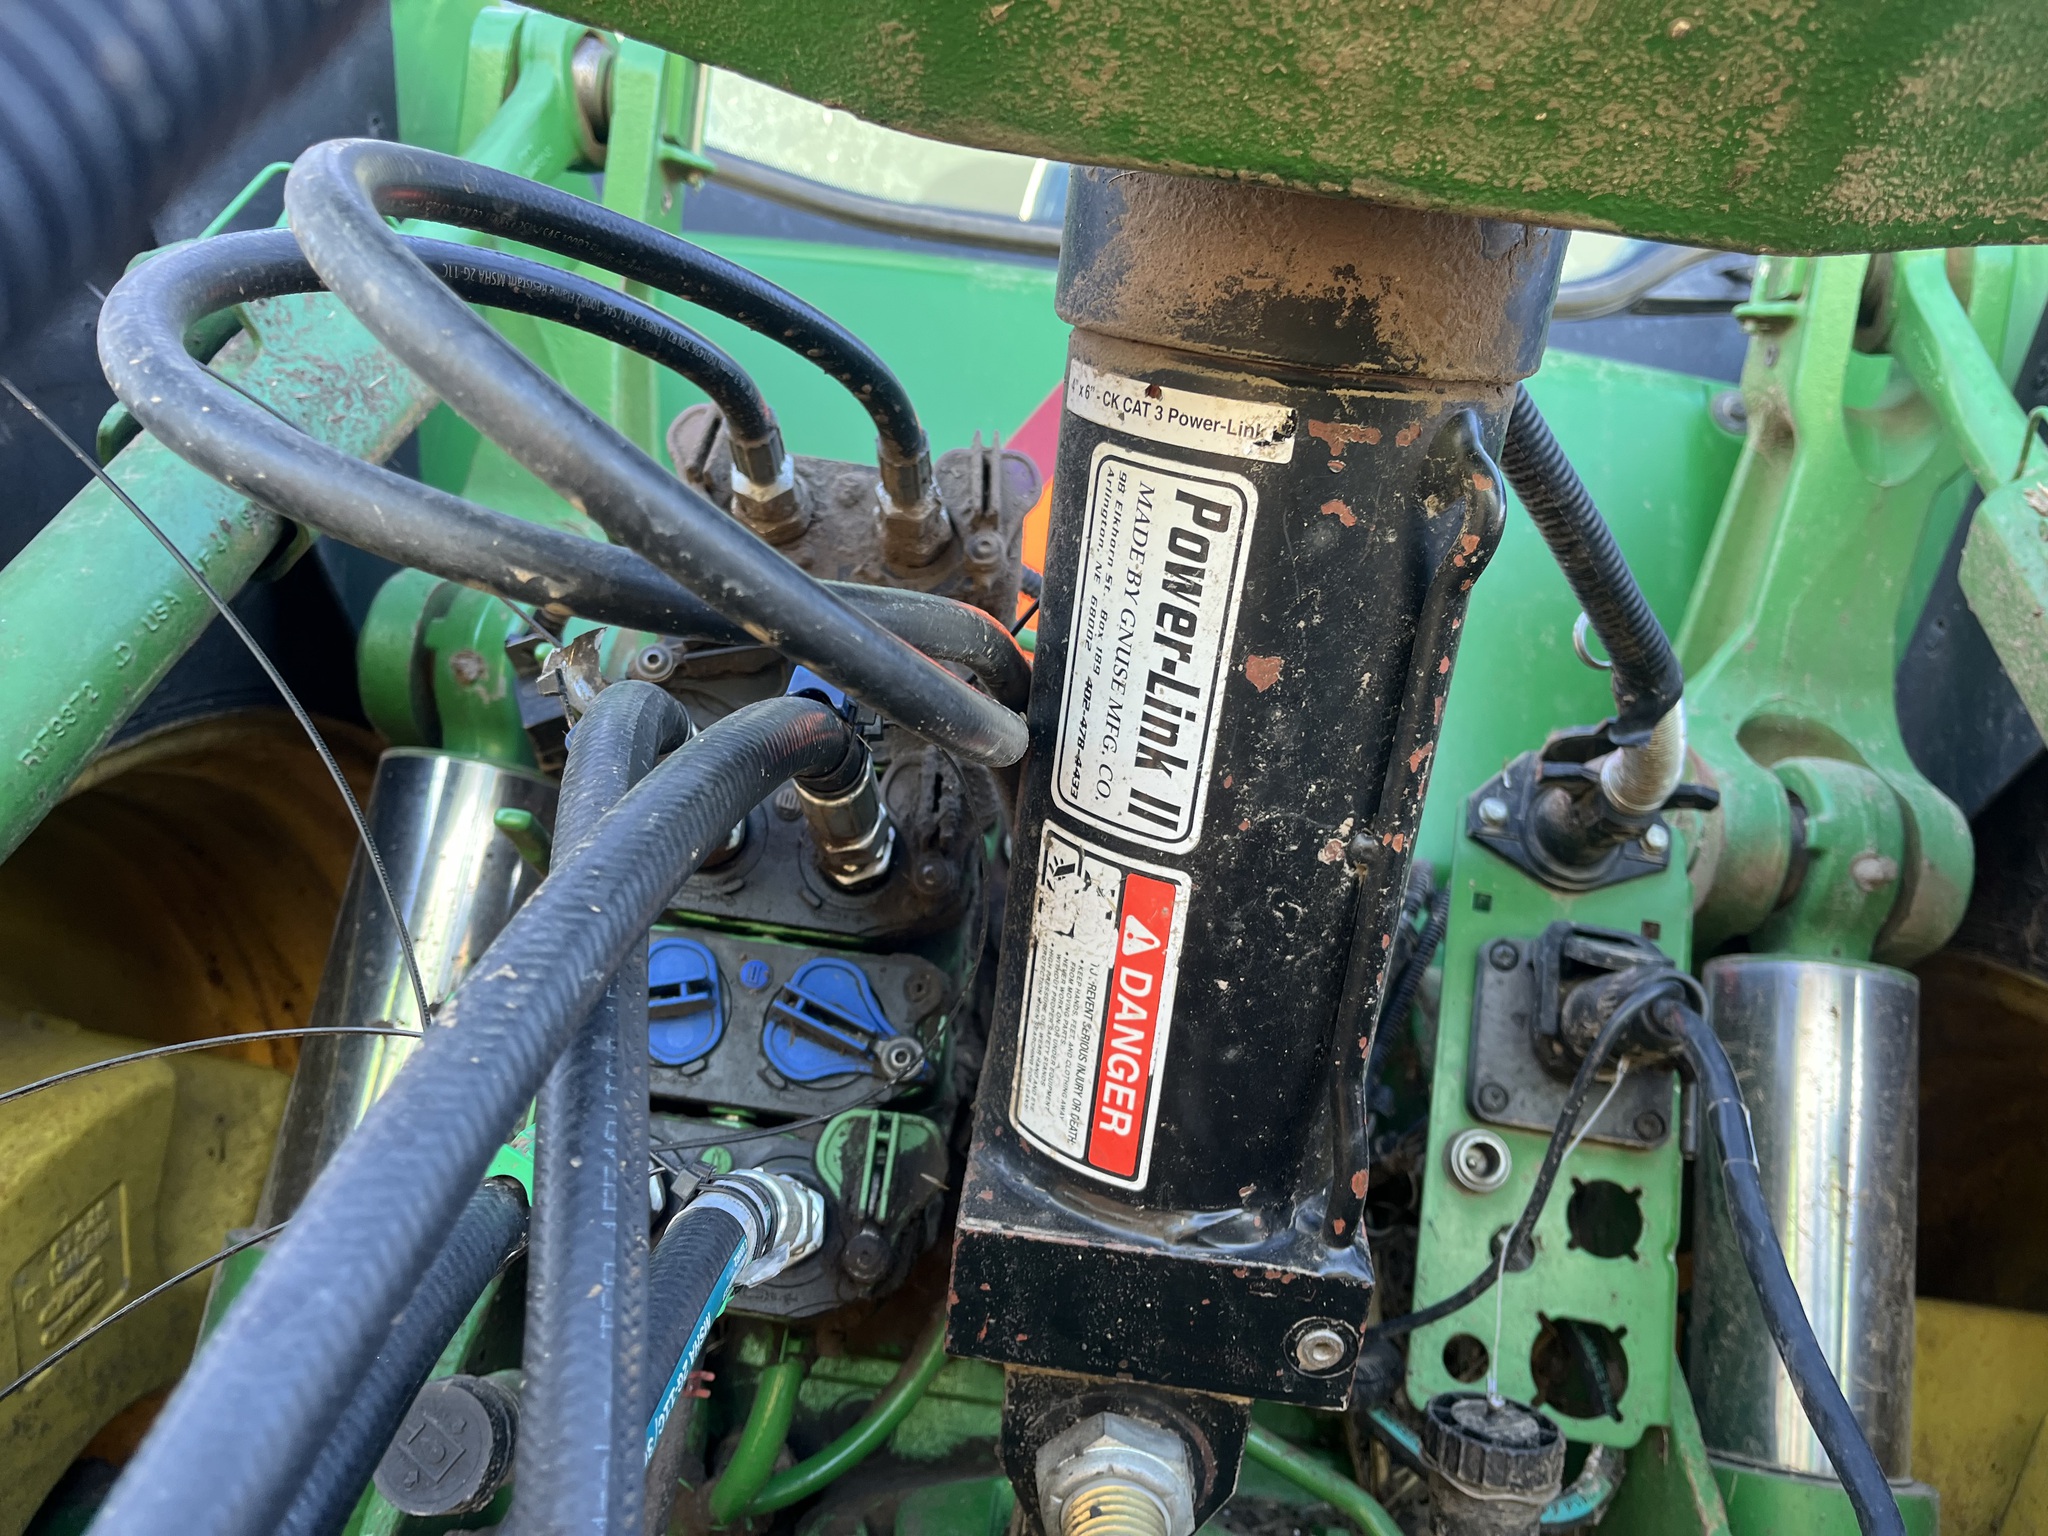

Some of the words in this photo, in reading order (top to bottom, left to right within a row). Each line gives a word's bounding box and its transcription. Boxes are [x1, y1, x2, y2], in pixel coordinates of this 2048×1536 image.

[442, 263, 476, 281] 2G-11C
[478, 270, 506, 287] MSHA
[507, 274, 548, 296] Resistant
[549, 285, 575, 304] Flame
[576, 293, 600, 312] 100R2
[603, 303, 617, 318] SAE
[1103, 391, 1119, 411] CK
[1123, 397, 1151, 418] CAT
[1155, 406, 1163, 421] 3
[1118, 470, 1128, 494] 98
[1096, 466, 1115, 552] Arlington,
[1130, 481, 1155, 565] MADE
[1107, 500, 1123, 567] Elkhorn
[1093, 561, 1102, 584] NE
[1103, 573, 1113, 597] St.
[1124, 567, 1143, 605] BY
[1084, 595, 1098, 652] 68002
[1095, 609, 1108, 639] Box
[1134, 489, 1232, 779] Power-Link
[1093, 646, 1103, 676] 189
[1109, 607, 1136, 696] GNUSE
[1070, 676, 1093, 800] 402-478-4433
[1101, 696, 1123, 755] MFG.
[1095, 764, 1114, 801] CO.
[1127, 788, 1182, 832] II
[1037, 944, 1047, 994] PROTECTION
[1053, 954, 1061, 990] WITHOUT
[1076, 965, 1084, 987] KEEP
[1041, 970, 1051, 1013] PRESSURE
[1048, 991, 1056, 1023] PROPER
[1064, 986, 1073, 1018] MOVING
[1072, 988, 1080, 1016] HANDS,
[1084, 976, 1097, 1021] REVENT
[1054, 1025, 1060, 1037] OR
[1056, 1012, 1062, 1023] ON
[1045, 1024, 1054, 1054] SAFETY
[1078, 1021, 1092, 1062] SERIOUS
[1099, 965, 1152, 1136] DANGER
[1045, 1068, 1054, 1111] EQUIPMENT
[1061, 1060, 1071, 1098] CLOTHING
[1072, 1063, 1086, 1098] INJURY
[1072, 1098, 1081, 1112] OR
